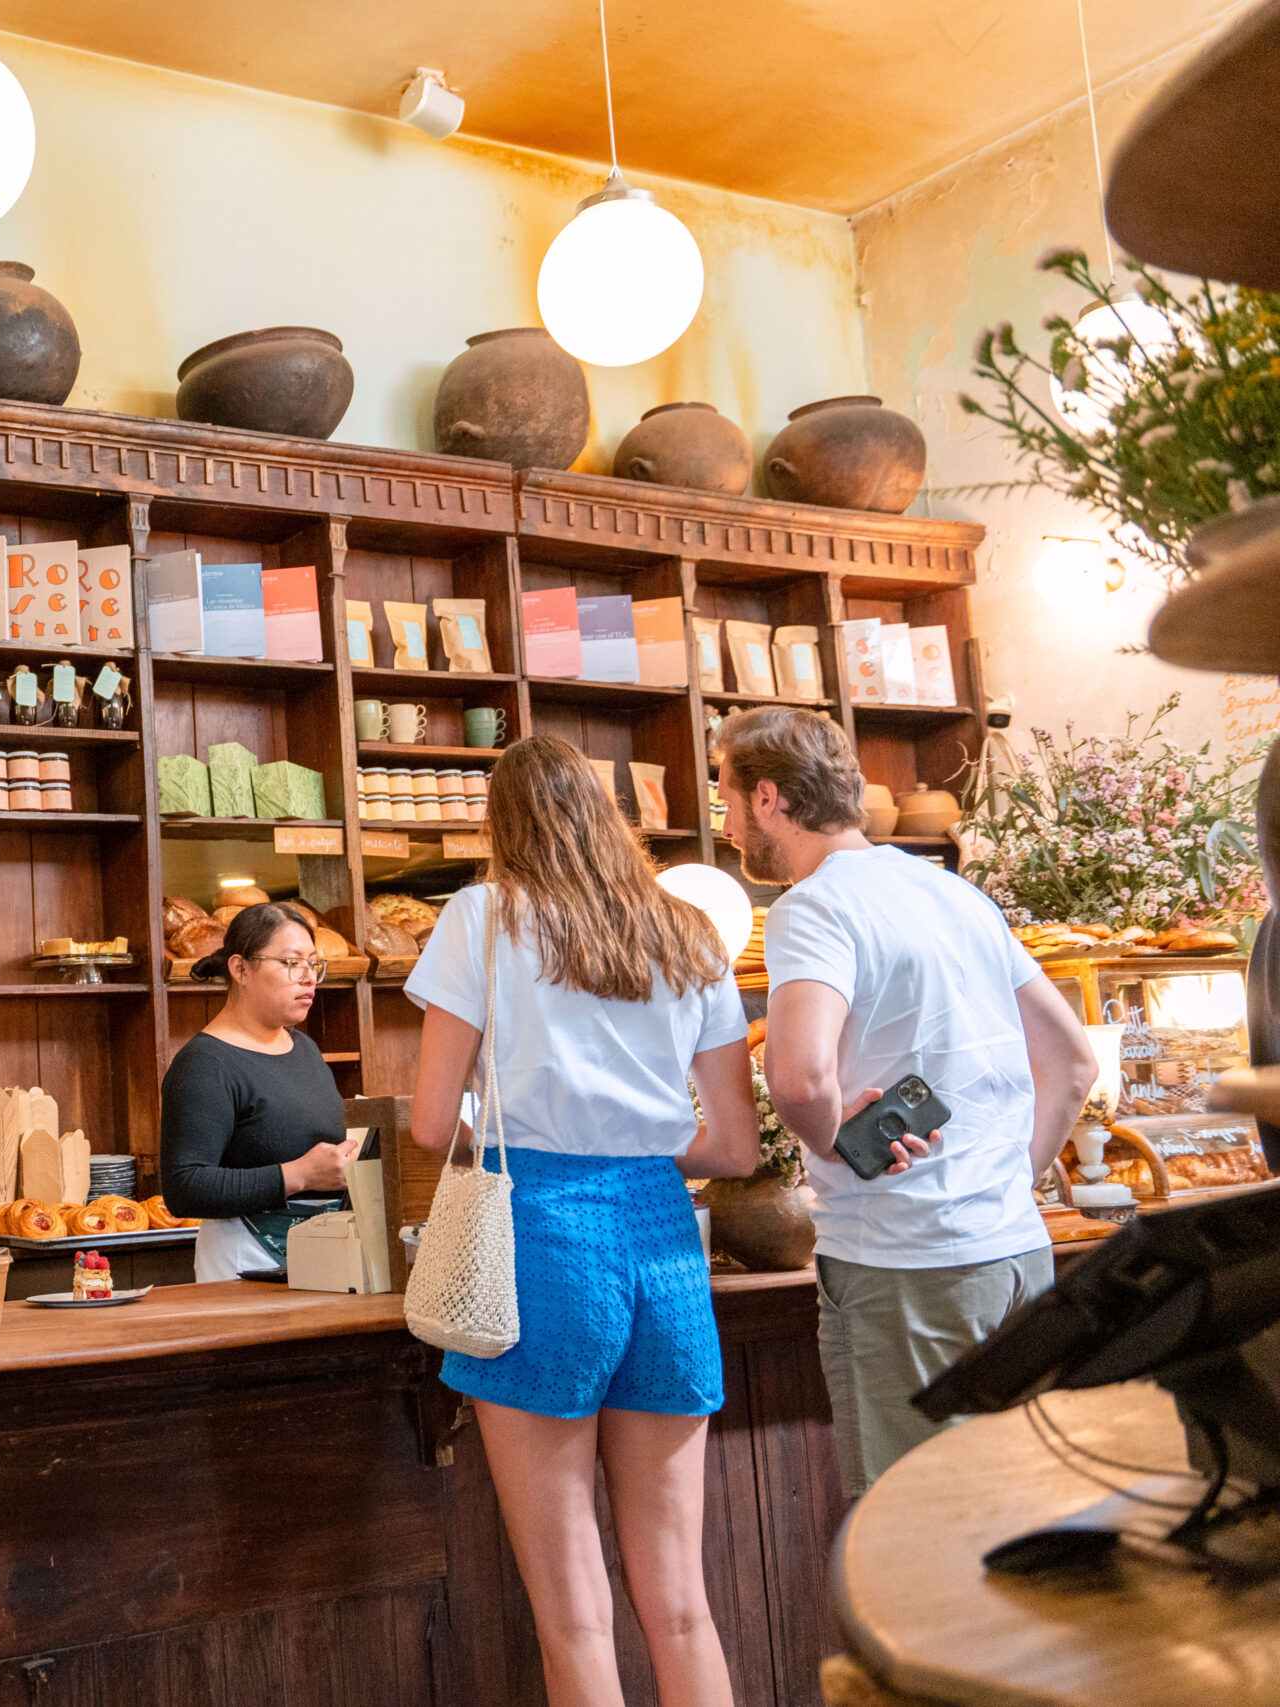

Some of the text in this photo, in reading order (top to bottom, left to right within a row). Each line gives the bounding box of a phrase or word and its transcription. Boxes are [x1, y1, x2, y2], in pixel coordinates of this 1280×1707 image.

[6, 553, 69, 589] Ro
[88, 625, 122, 642] ta
[1120, 1070, 1168, 1104] Canela
